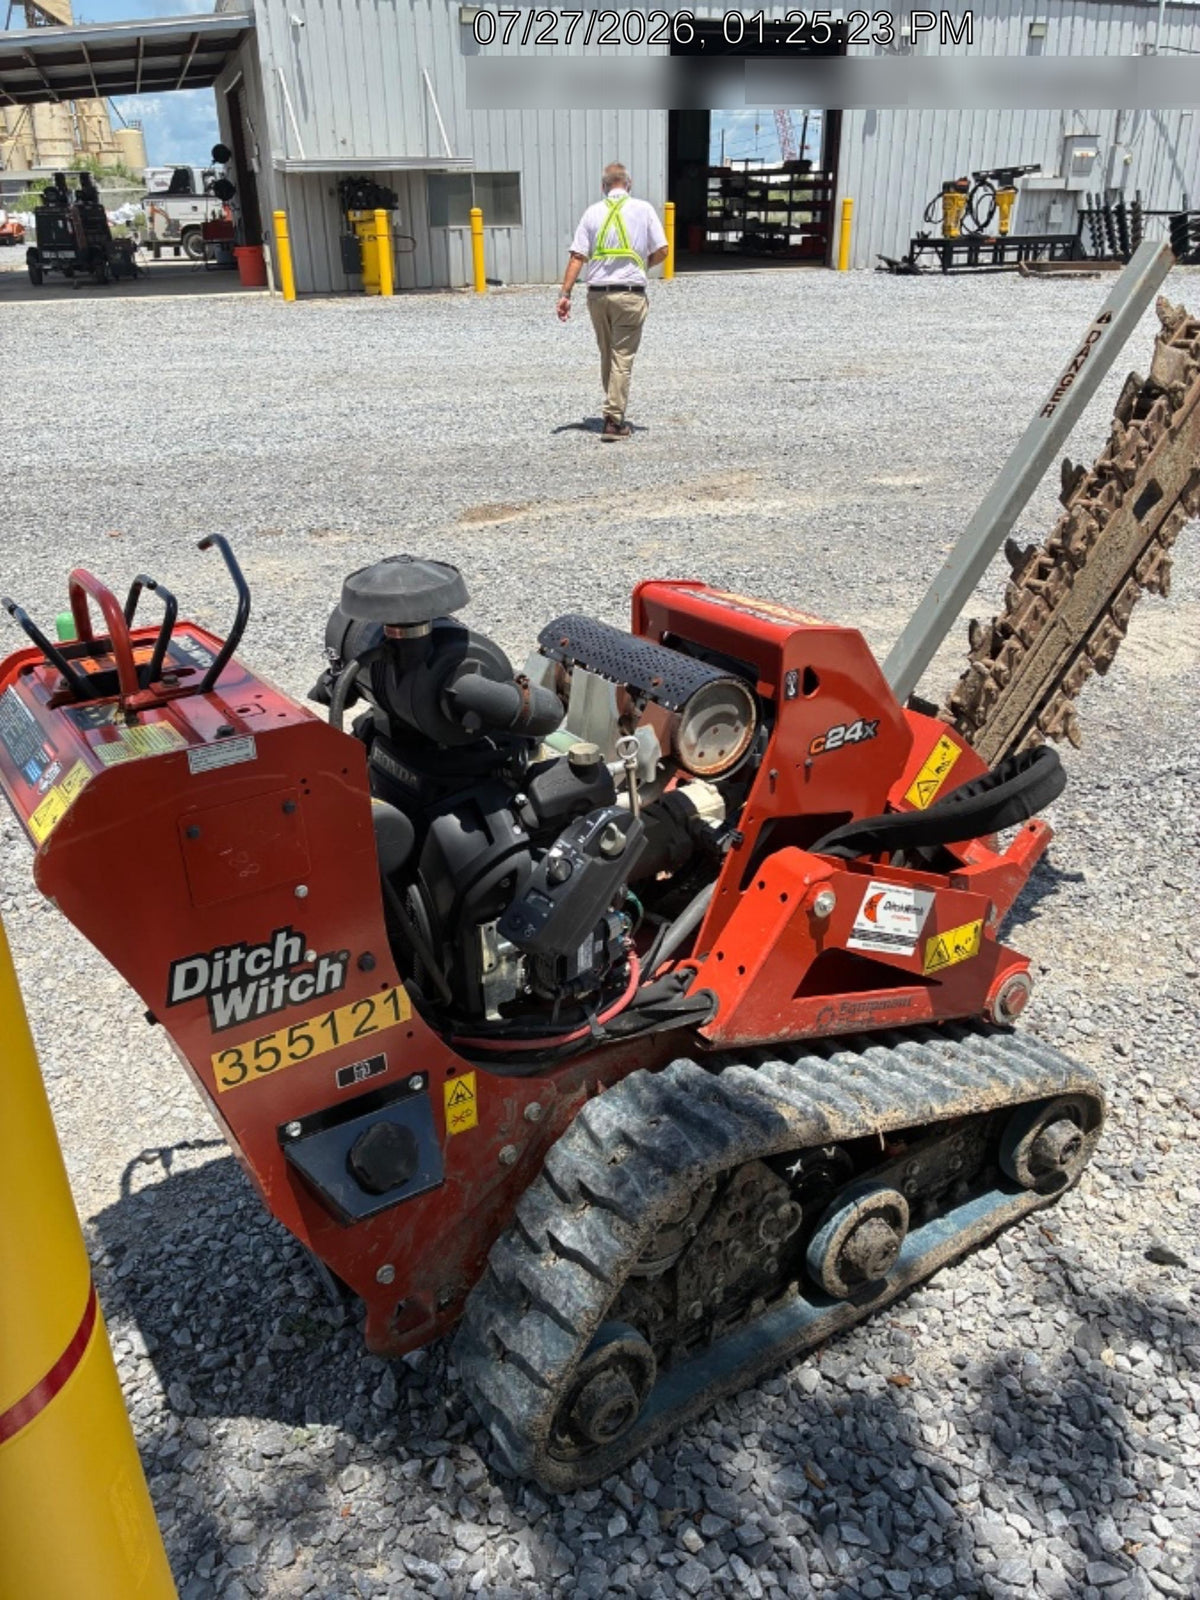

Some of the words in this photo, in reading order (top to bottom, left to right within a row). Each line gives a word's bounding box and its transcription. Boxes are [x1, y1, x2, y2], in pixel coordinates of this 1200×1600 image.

[1040, 330, 1102, 418] DANGER
[172, 931, 301, 1002] Ditch
[210, 958, 344, 1029] Witch
[218, 989, 402, 1087] 355121
